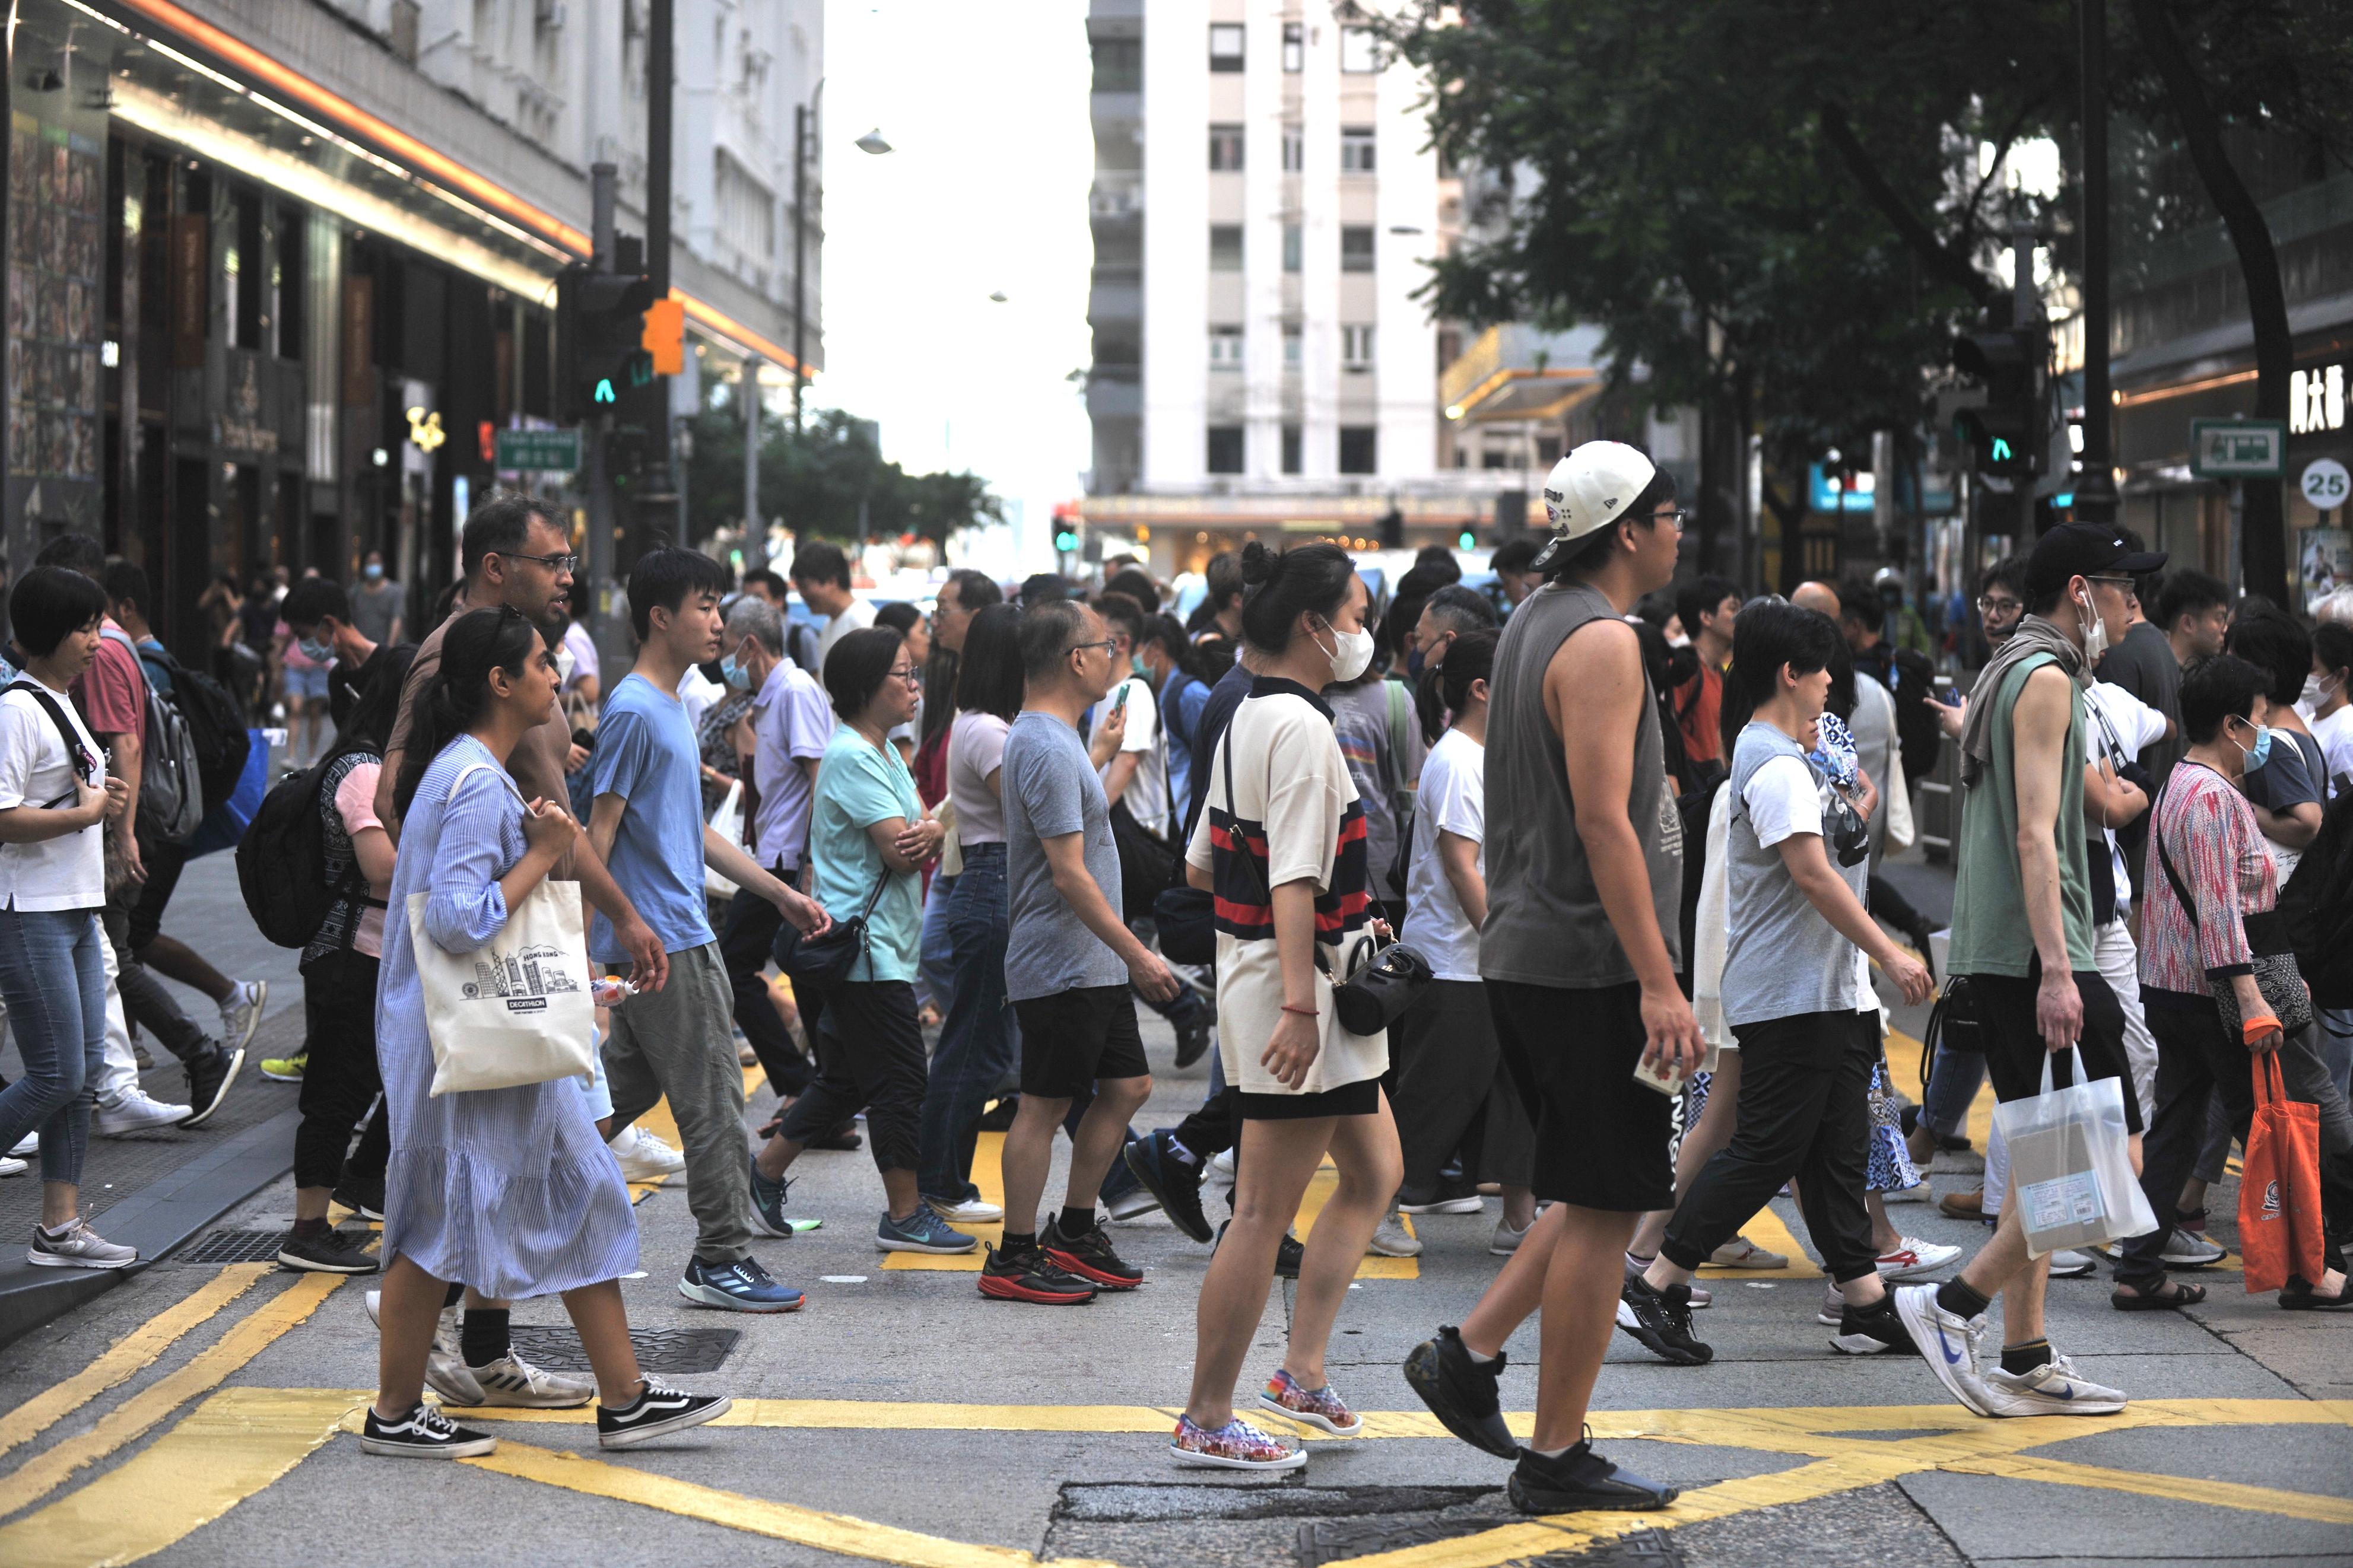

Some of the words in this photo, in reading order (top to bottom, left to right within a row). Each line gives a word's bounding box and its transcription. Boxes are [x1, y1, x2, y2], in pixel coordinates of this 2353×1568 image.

[2308, 473, 2344, 496] 25
[523, 952, 541, 961] HONG
[510, 1000, 545, 1008] DECATHLON
